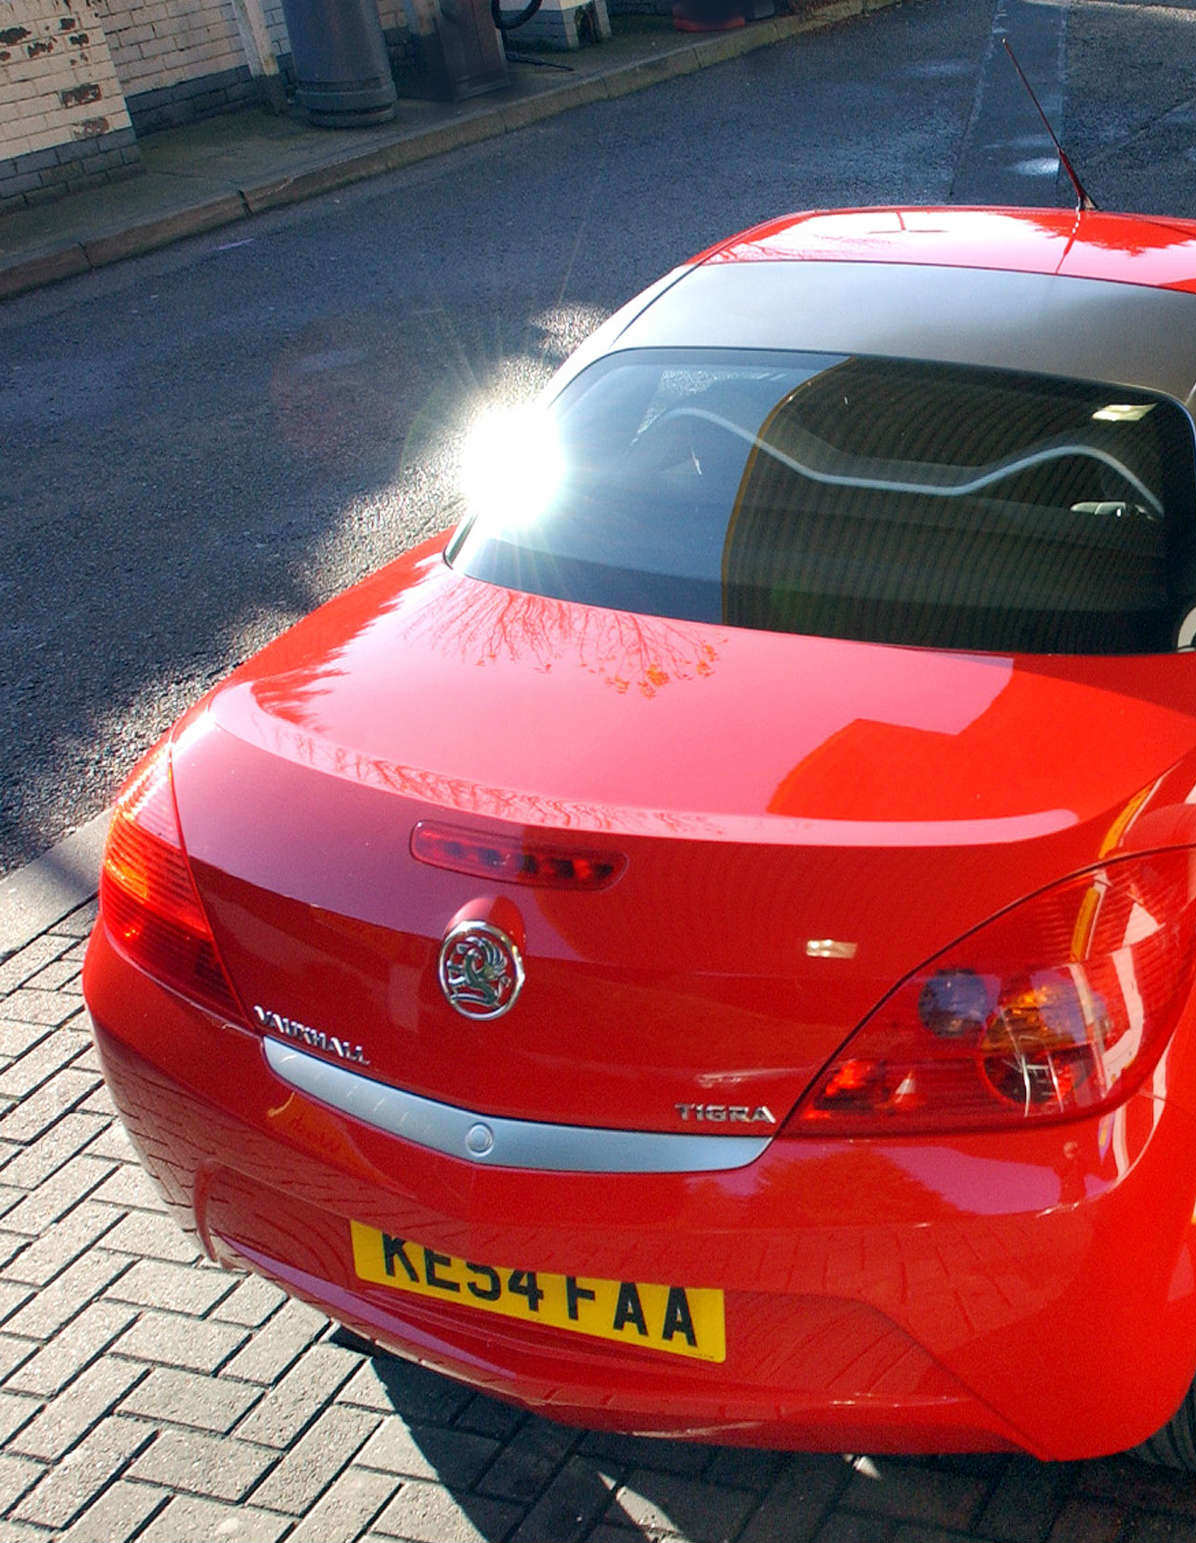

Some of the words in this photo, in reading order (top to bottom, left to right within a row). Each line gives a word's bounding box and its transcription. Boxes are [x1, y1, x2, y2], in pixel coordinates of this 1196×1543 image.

[253, 1005, 371, 1066] VAUXHALL
[674, 1103, 776, 1124] TIGRA
[382, 1232, 544, 1312] KE54
[565, 1275, 698, 1348] FAA
